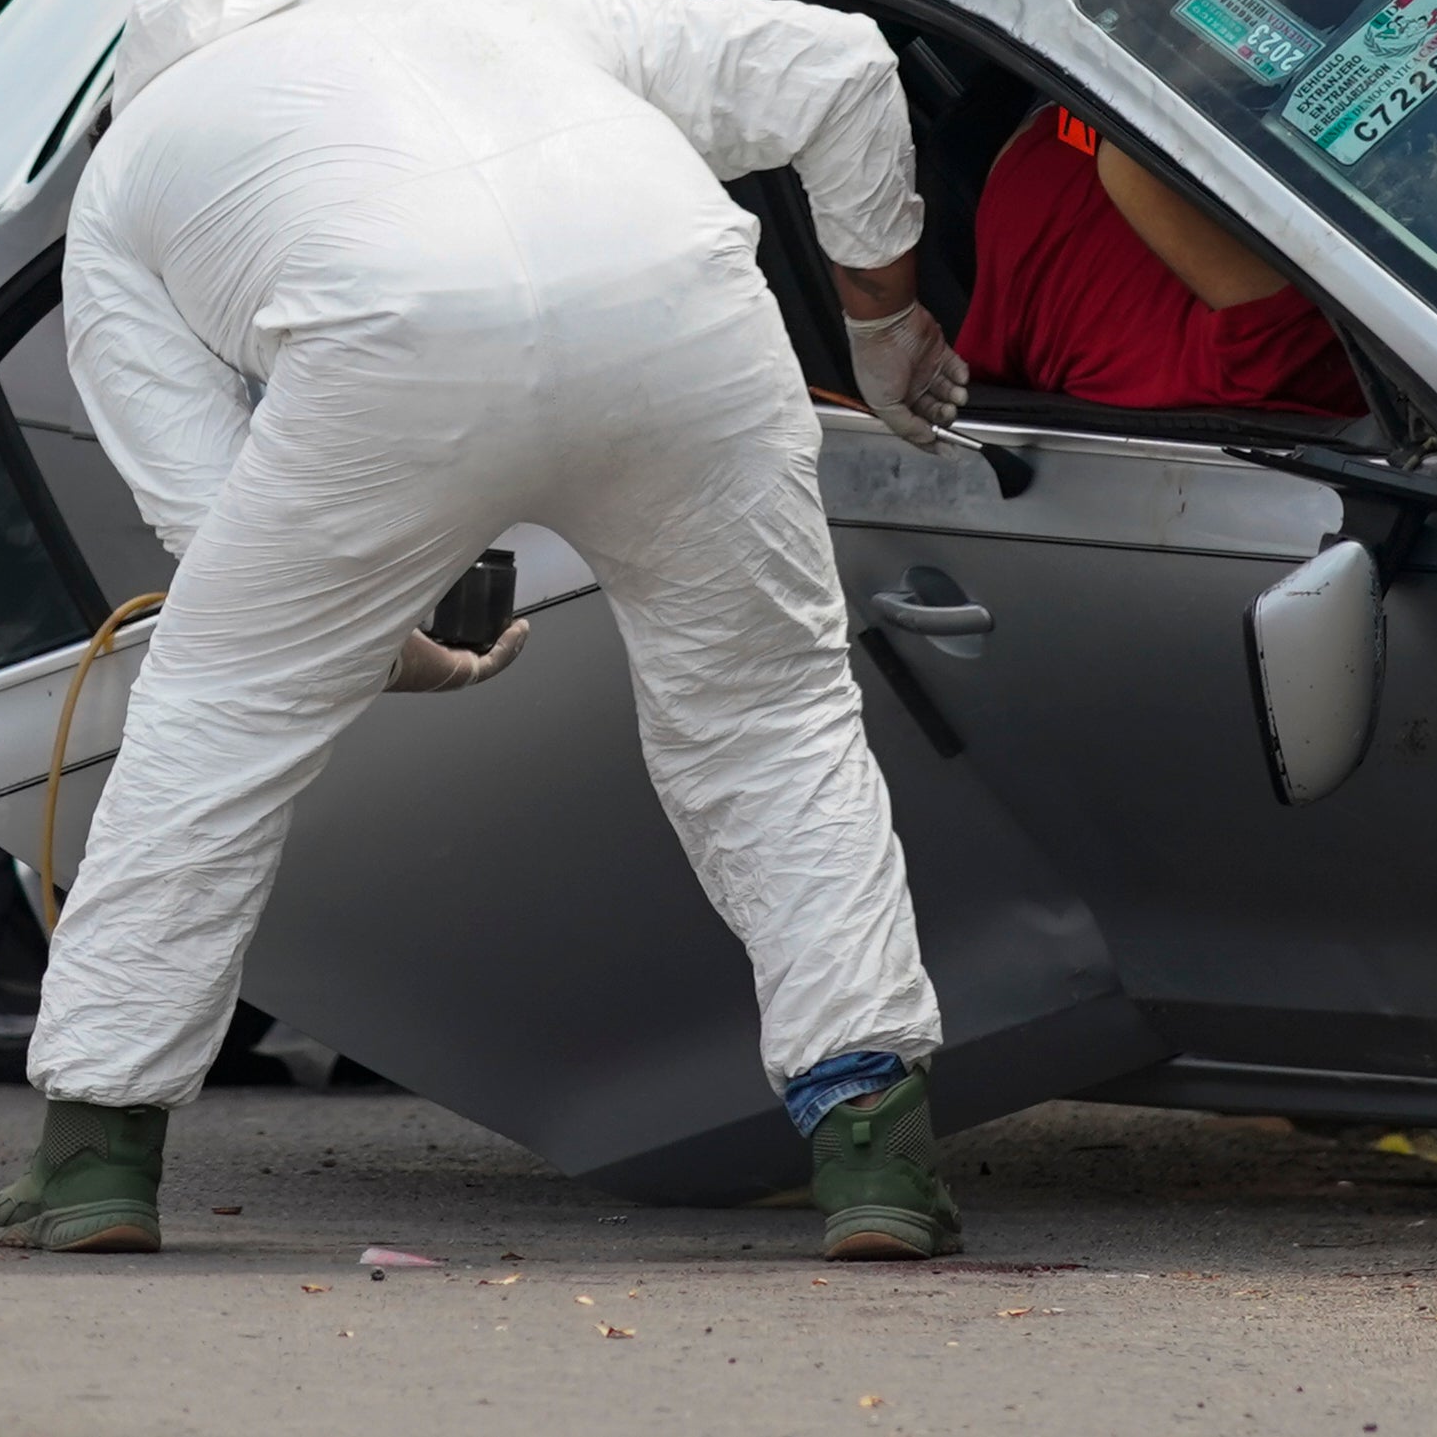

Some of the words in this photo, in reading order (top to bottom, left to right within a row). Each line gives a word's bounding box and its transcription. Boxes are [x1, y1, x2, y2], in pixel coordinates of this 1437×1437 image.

[1247, 24, 1305, 71] 2023
[1267, 14, 1313, 51] VIGENCIA
[1295, 54, 1344, 99] VEHICULO
[1297, 55, 1362, 114] EXTRANJERO
[1309, 104, 1327, 120] EN
[1324, 66, 1370, 106] TRAMITE
[1309, 122, 1323, 137] DE
[1322, 63, 1391, 125] REGULARIZACION
[1320, 111, 1355, 145] UNION
[1351, 56, 1419, 117] DEMOCRATICA
